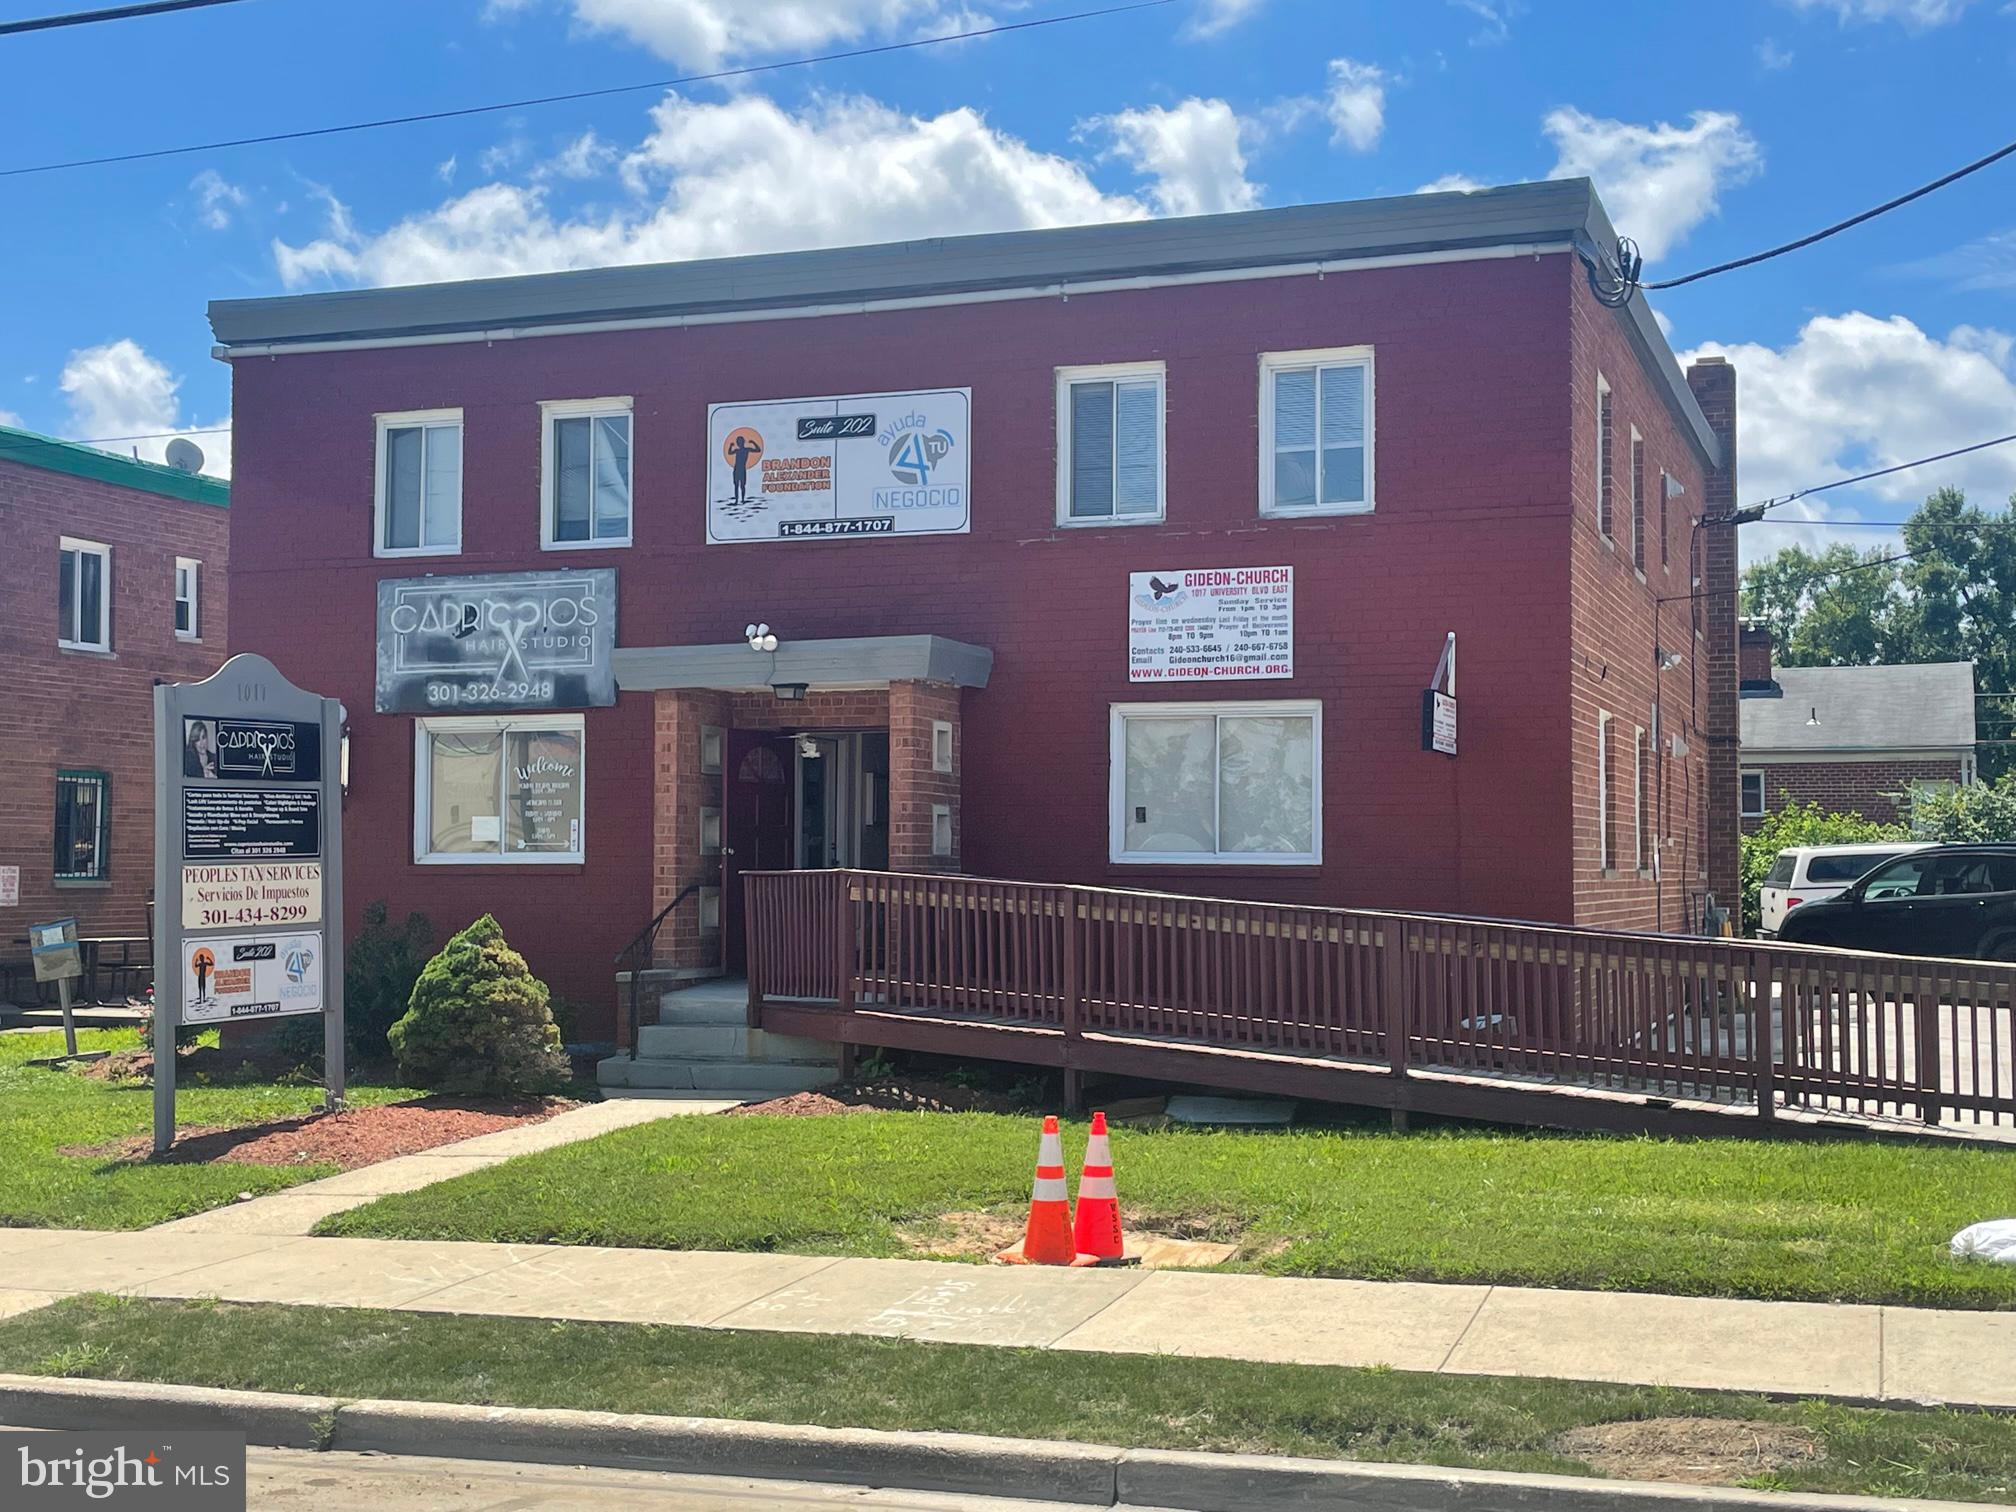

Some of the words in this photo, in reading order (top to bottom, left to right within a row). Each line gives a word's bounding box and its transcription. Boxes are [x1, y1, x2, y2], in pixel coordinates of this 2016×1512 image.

[799, 421, 834, 438] Suite
[838, 417, 872, 434] 202
[877, 410, 926, 447] ayuda
[928, 440, 948, 454] TU
[761, 455, 832, 471] BRANDON
[762, 470, 831, 482] ALEXANDER
[761, 481, 831, 493] FOUNDATION
[875, 489, 960, 509] NEGOCIO
[781, 520, 892, 536] 1-844-877-1707
[1184, 569, 1289, 587] GIDEON-CHURCH
[1191, 588, 1207, 597] 1017
[1210, 587, 1248, 596] UNIVERSITY
[1252, 586, 1269, 595] BLVD
[1272, 585, 1288, 594] EAST
[1218, 598, 1249, 606] Sunday
[1232, 616, 1249, 624] Friday
[1168, 633, 1182, 641] 8pm
[1186, 632, 1195, 640] TO
[1199, 632, 1214, 640] 9pm
[1240, 630, 1257, 638] 10pm
[1261, 629, 1270, 637] TO
[465, 639, 509, 652] HAIR
[522, 635, 592, 650] STUDIO
[1131, 647, 1165, 655] Contacts
[1169, 644, 1222, 654] 240-533-6645
[1234, 642, 1289, 651] 240-667-6758
[1131, 656, 1153, 664] Email
[428, 682, 551, 701] 301-326-2948
[513, 756, 576, 780] Welcome
[185, 867, 239, 884] PEOPLES
[241, 866, 264, 882] TAX
[266, 865, 320, 881] SERVICES
[197, 886, 243, 902] Servicios
[246, 886, 259, 900] De
[262, 885, 310, 903] Impuestos
[200, 905, 307, 925] 301-434-8299
